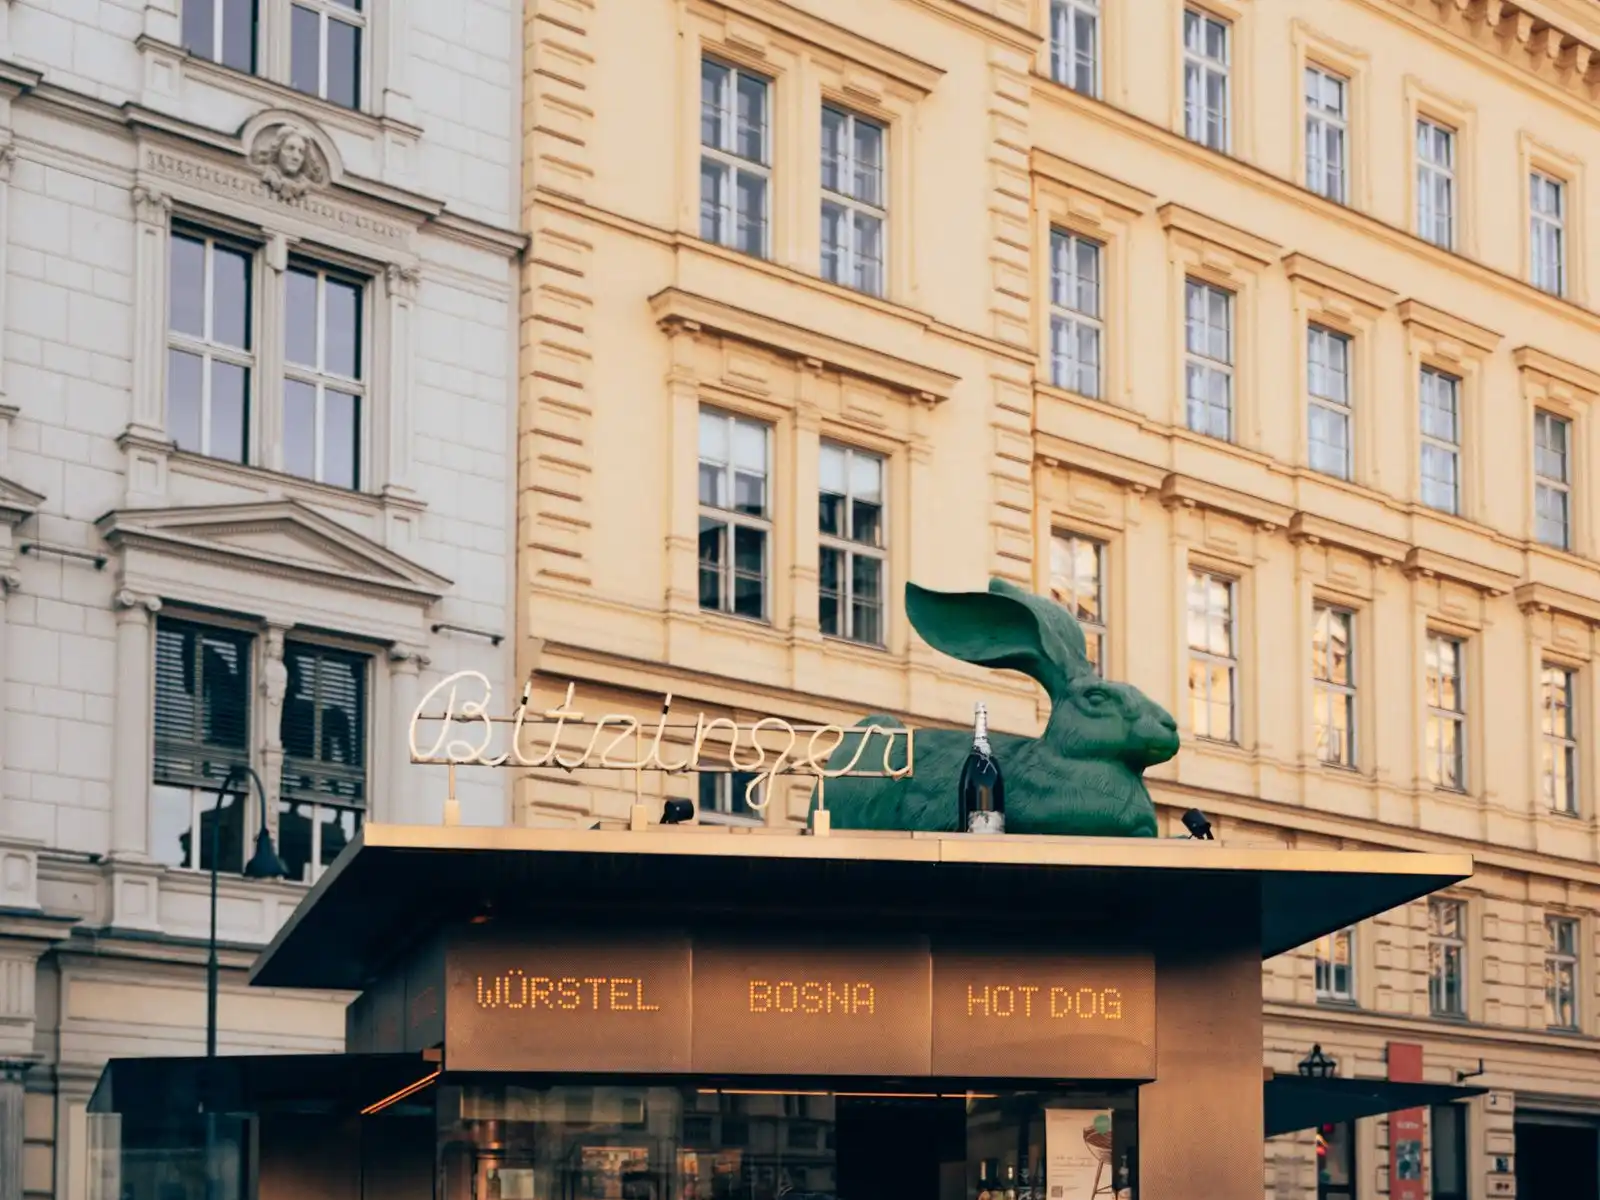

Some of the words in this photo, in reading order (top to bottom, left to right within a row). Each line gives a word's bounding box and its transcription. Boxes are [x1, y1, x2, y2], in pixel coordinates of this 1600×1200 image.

[408, 669, 911, 811] Bitzinger
[476, 969, 660, 1011] WÜRSTEL
[748, 979, 876, 1015] BOSNA
[966, 984, 1040, 1018] HOT
[1049, 986, 1123, 1020] DOG
